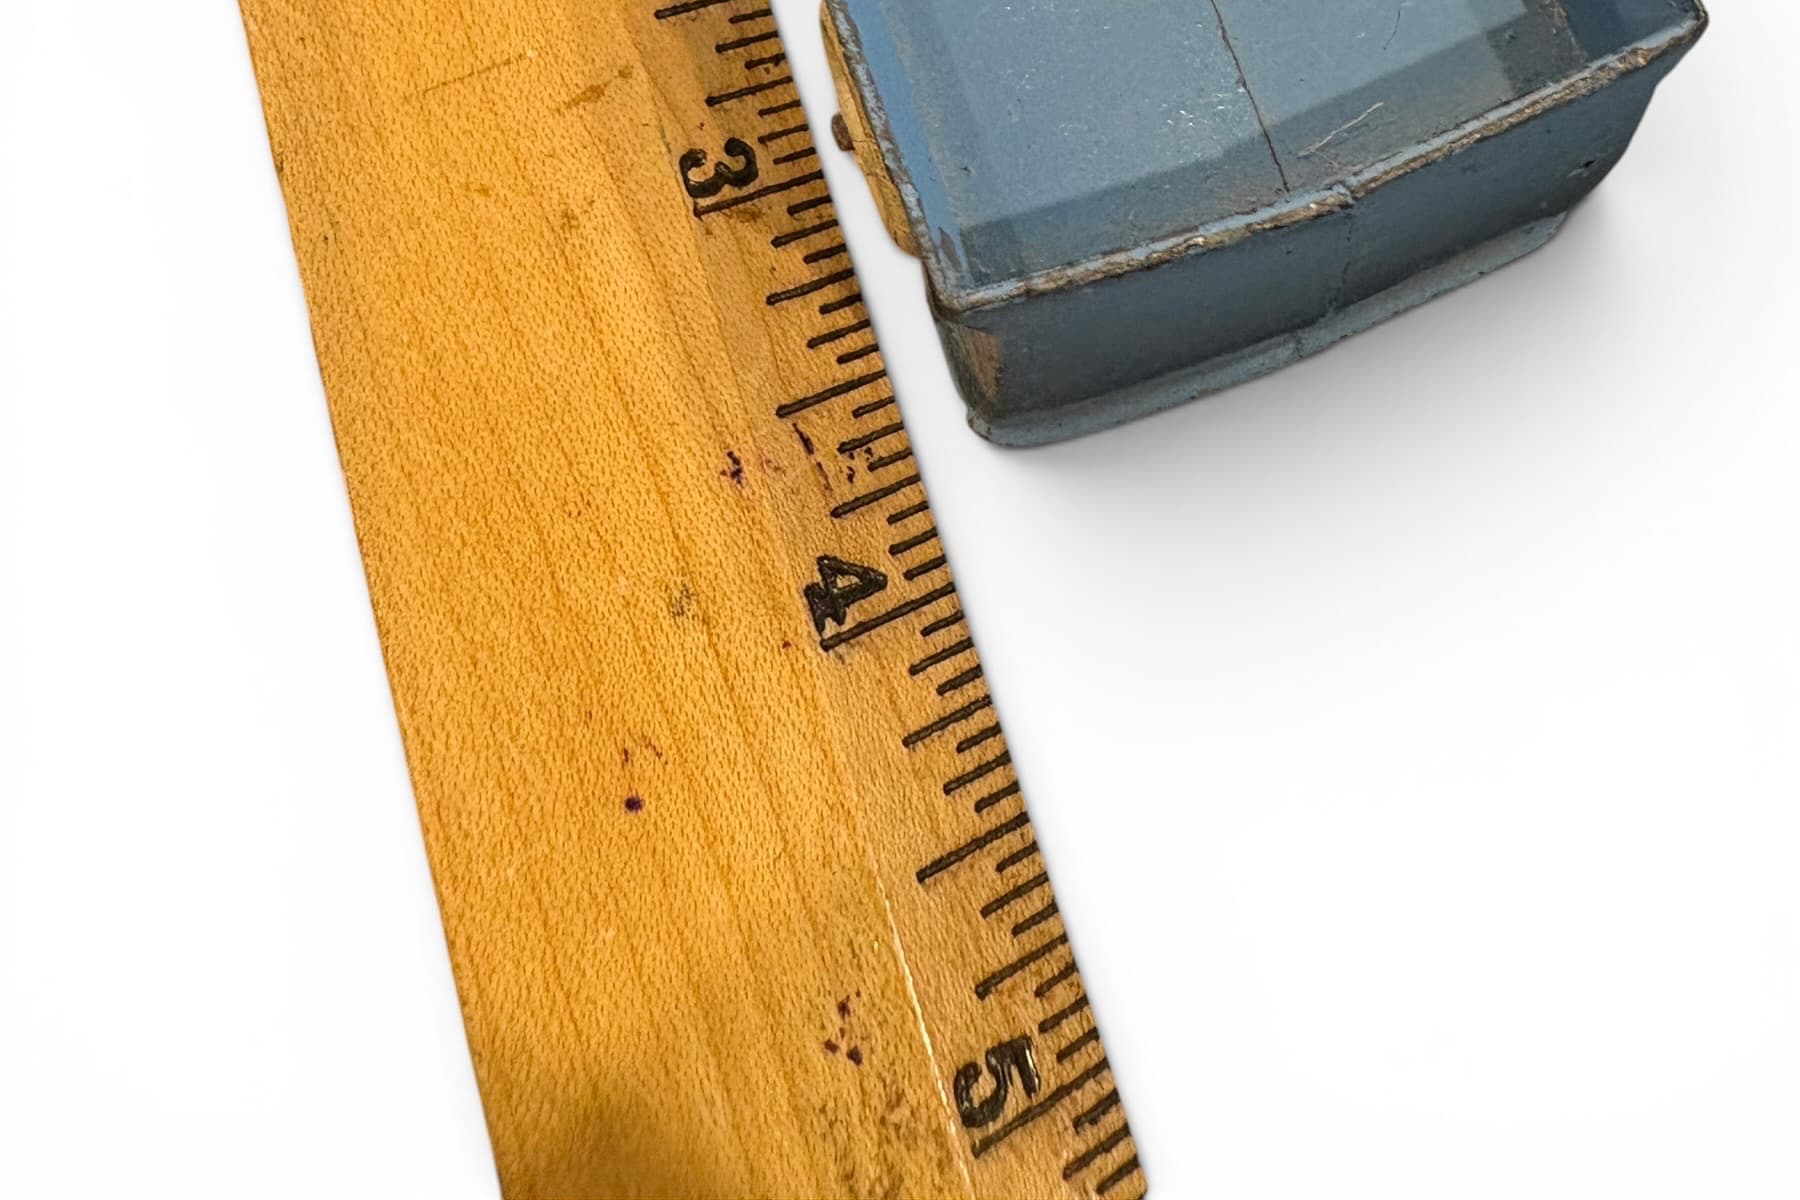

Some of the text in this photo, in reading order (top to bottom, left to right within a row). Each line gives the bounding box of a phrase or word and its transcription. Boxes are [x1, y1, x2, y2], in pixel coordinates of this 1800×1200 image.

[679, 137, 759, 199] 3
[803, 554, 888, 634] 4
[954, 1034, 1041, 1128] 5
